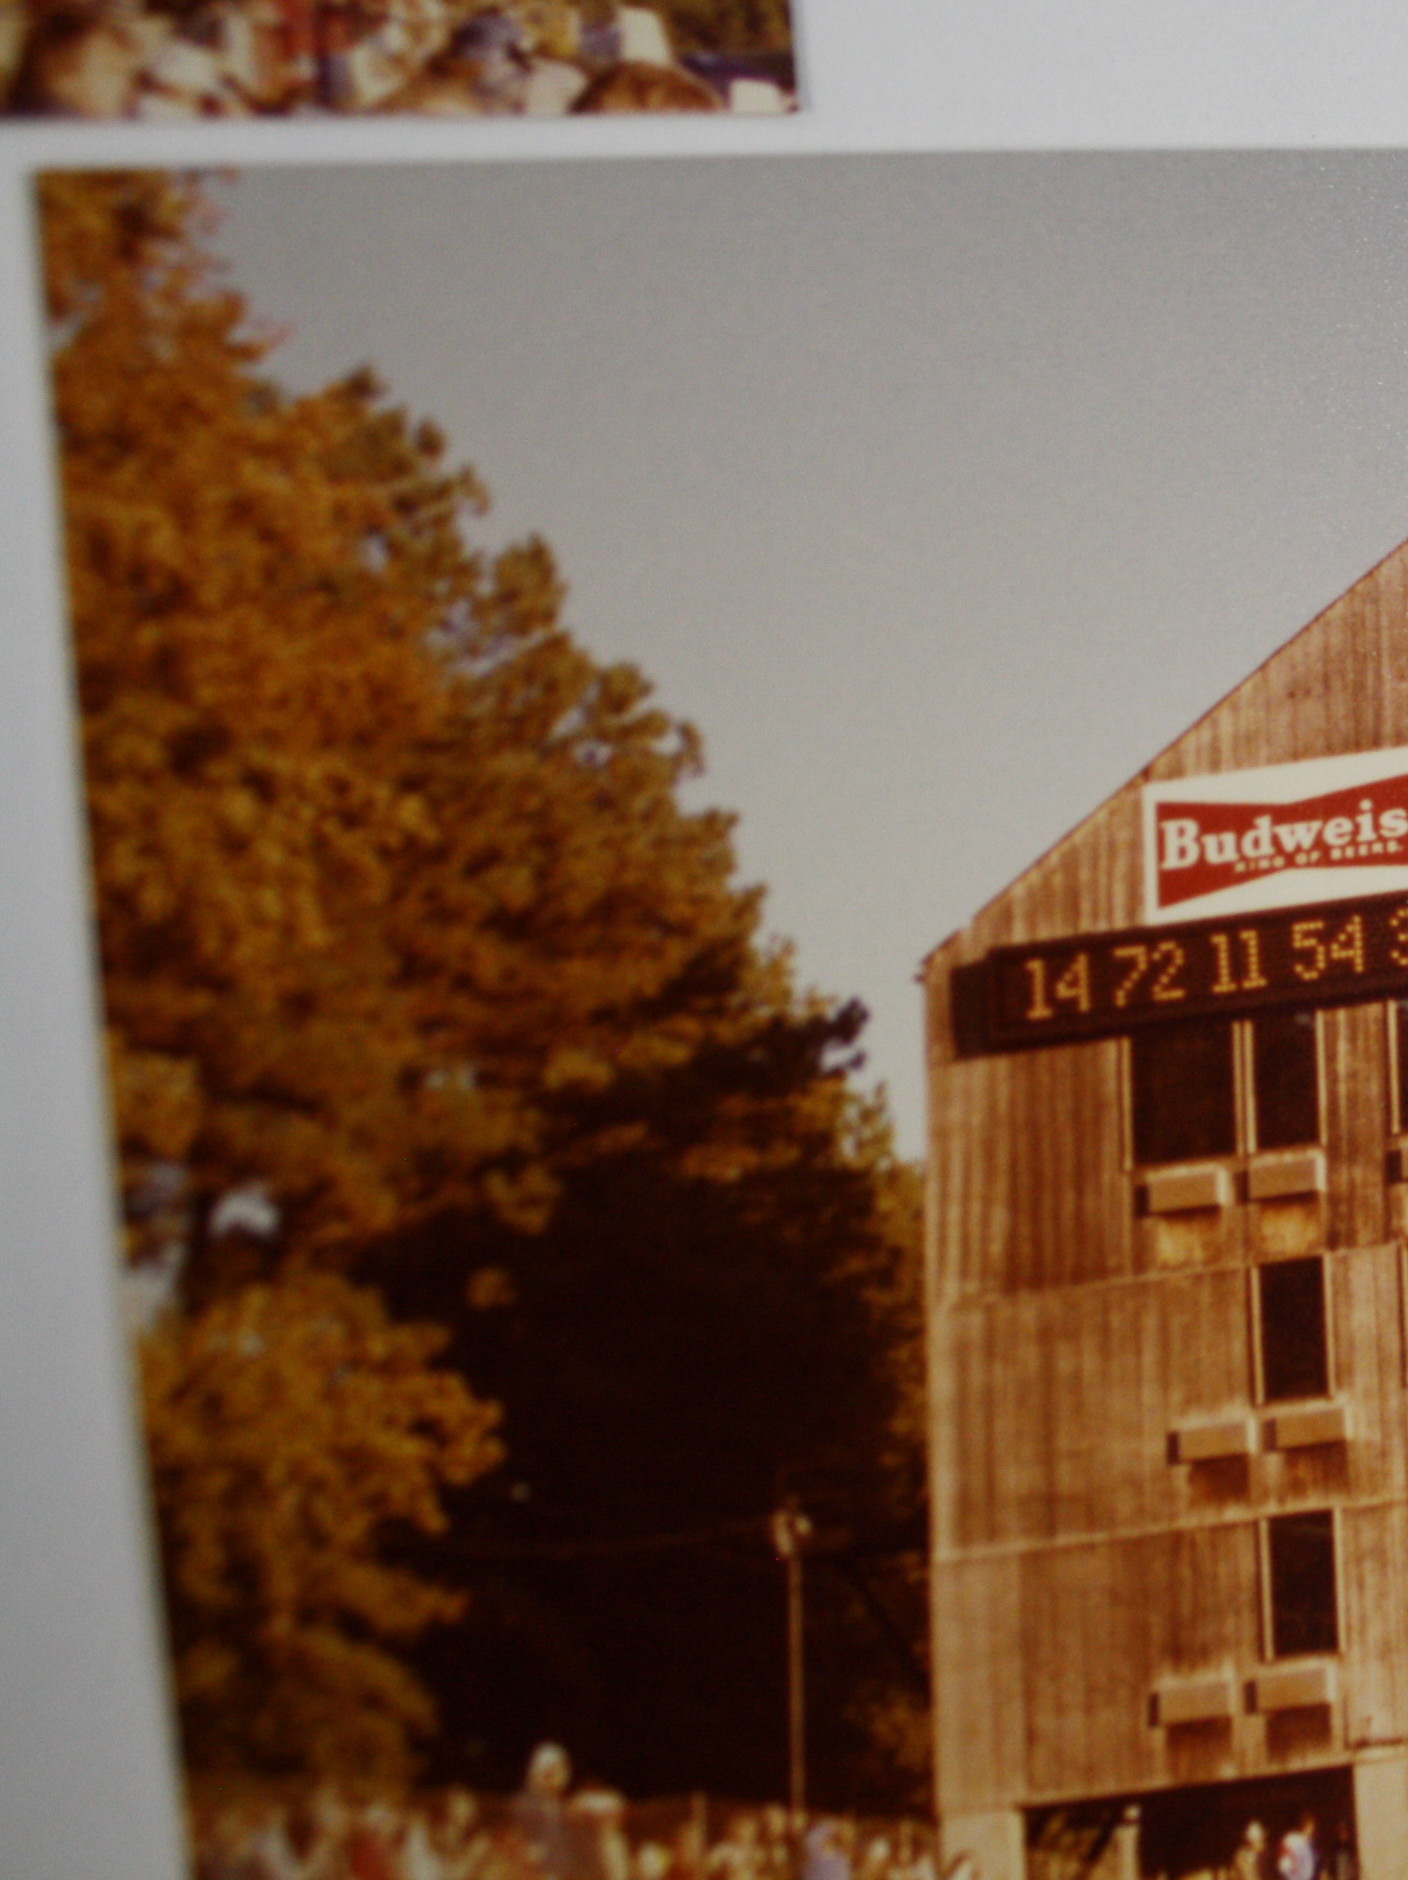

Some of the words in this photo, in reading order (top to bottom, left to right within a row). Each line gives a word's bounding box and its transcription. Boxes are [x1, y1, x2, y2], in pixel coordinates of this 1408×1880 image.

[1024, 953, 1090, 1020] 14
[1113, 941, 1186, 1007] 72
[1210, 929, 1268, 994] 11
[1293, 914, 1364, 981] 54
